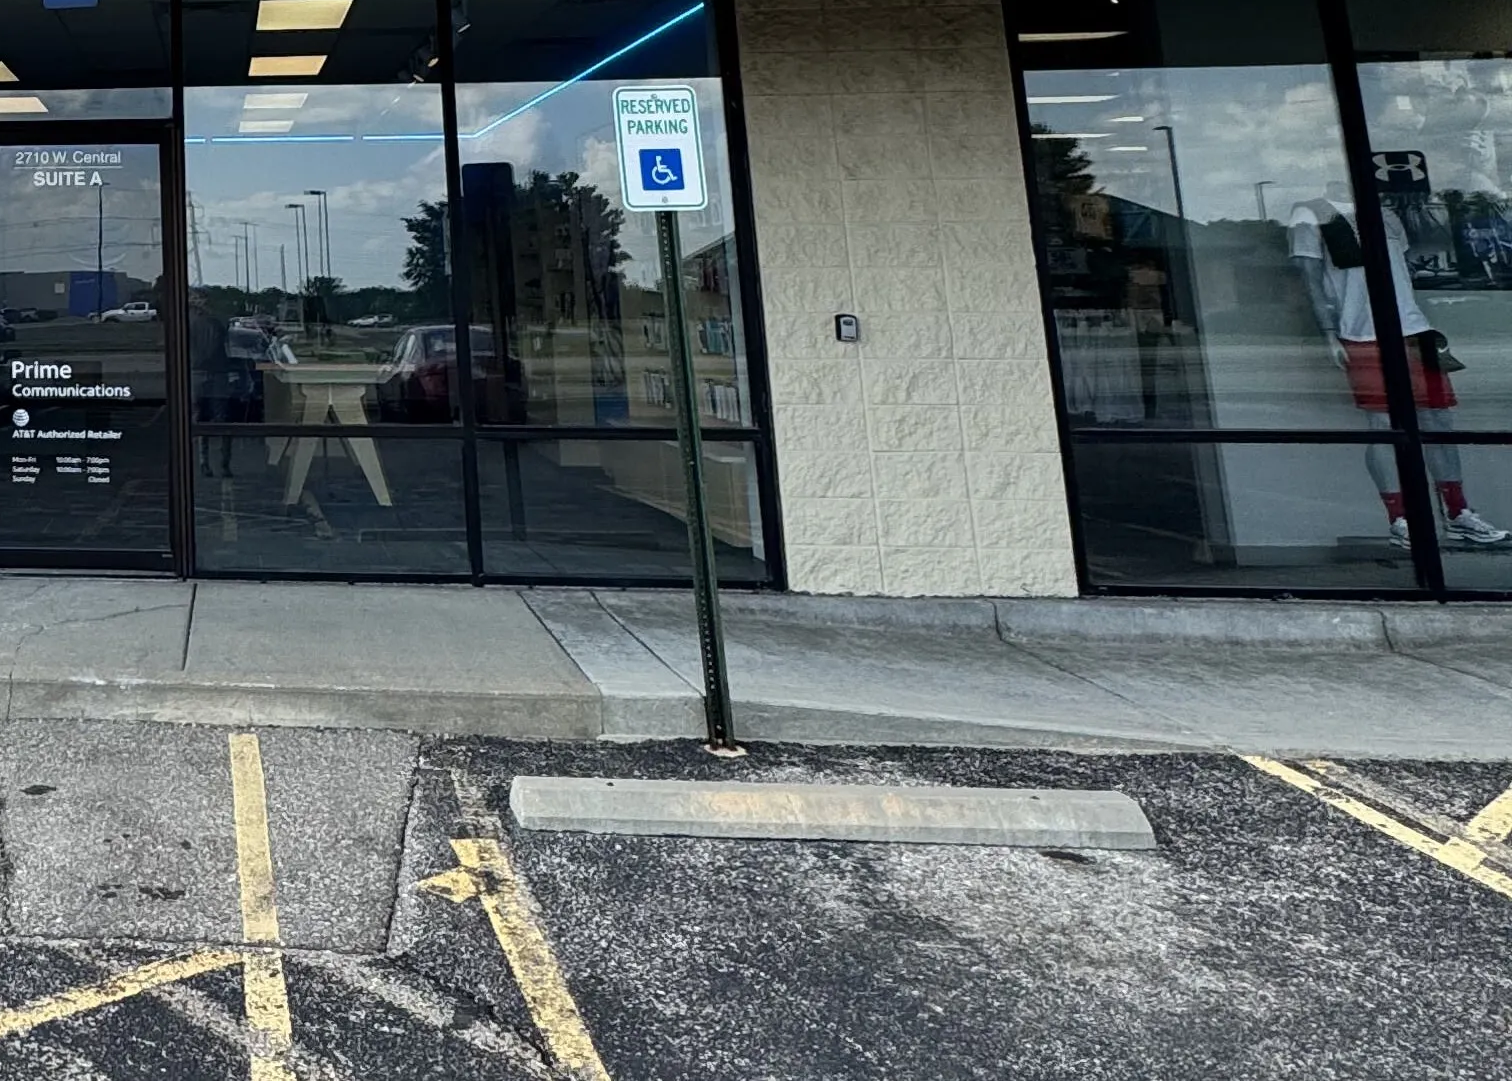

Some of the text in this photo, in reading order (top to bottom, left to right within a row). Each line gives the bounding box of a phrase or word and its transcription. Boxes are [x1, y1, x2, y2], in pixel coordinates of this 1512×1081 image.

[620, 97, 691, 115] RESERVED
[627, 118, 689, 135] PARKING
[15, 151, 49, 165] 2710
[72, 150, 122, 164] Central
[33, 171, 103, 187] SUITE A
[11, 360, 72, 379] Prime
[11, 383, 132, 397] Communications
[12, 429, 123, 439] AT&T Authorized Retailer
